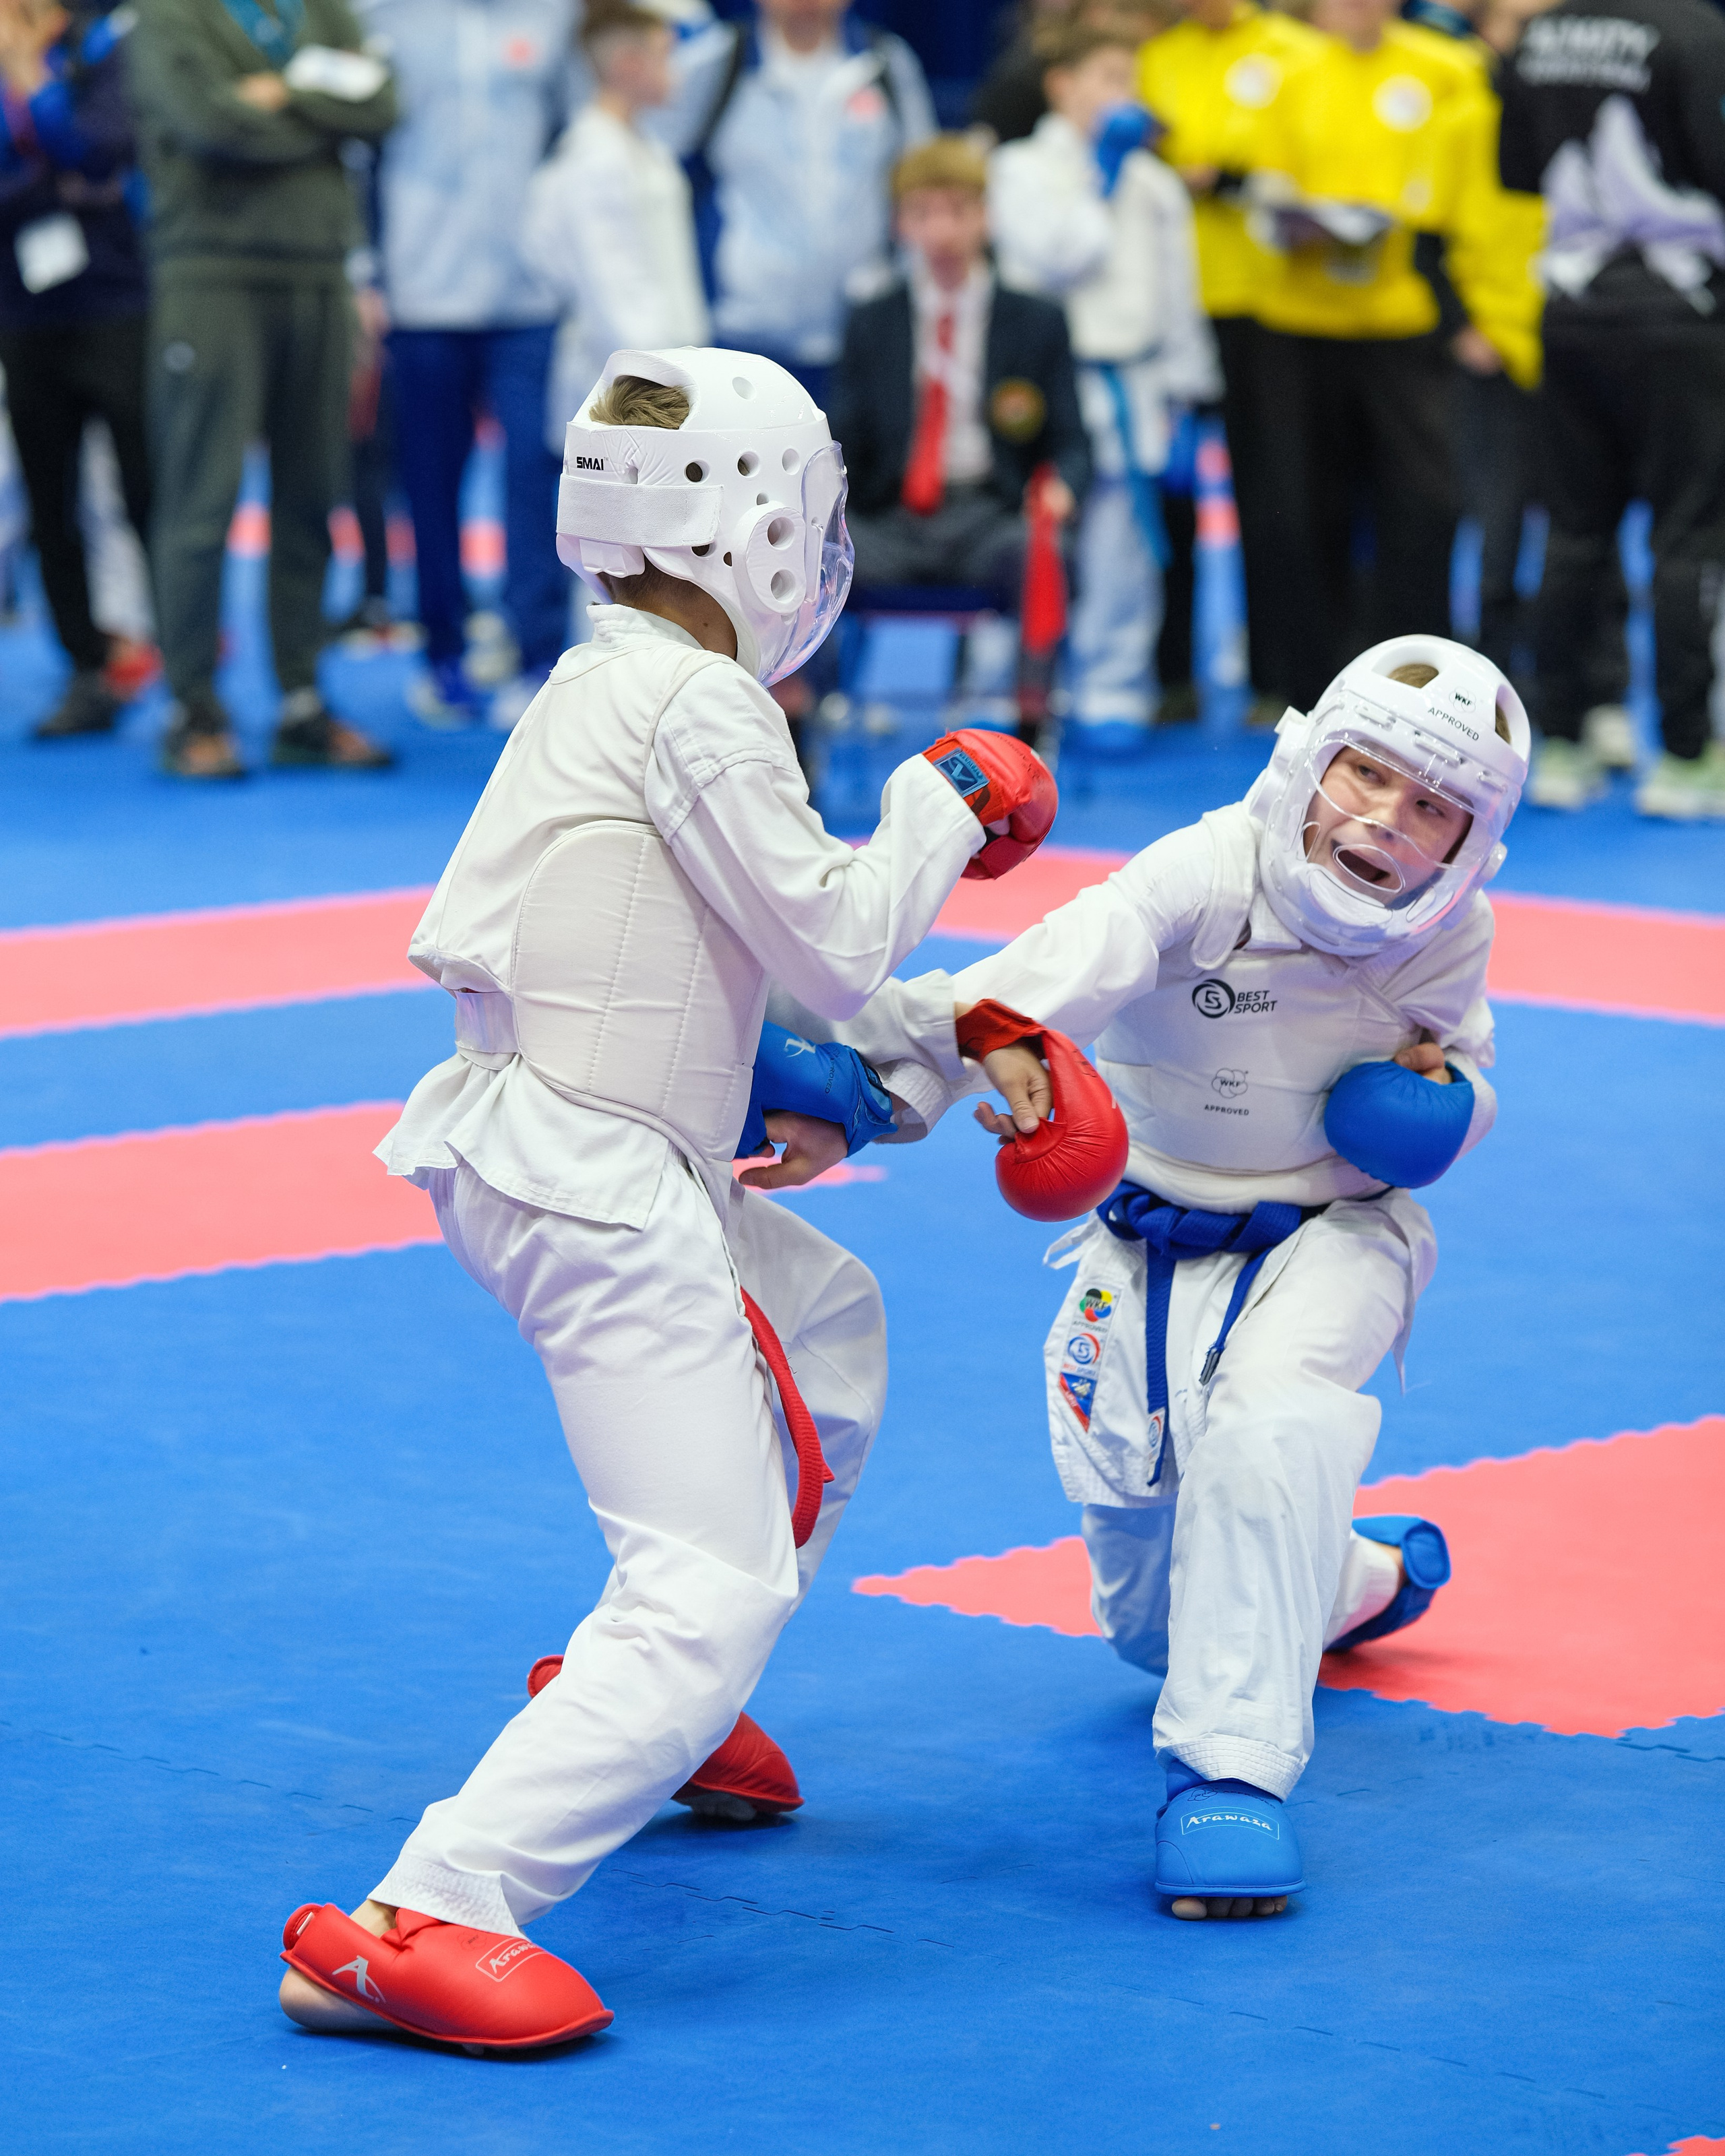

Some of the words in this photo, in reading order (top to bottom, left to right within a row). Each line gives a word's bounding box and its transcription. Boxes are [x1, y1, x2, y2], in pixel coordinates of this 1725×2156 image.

[1427, 707, 1479, 741] APPROVED
[1237, 990, 1270, 1003] BEST
[1233, 1000, 1278, 1014] SPORT
[1204, 1104, 1249, 1116] APPROVED
[1186, 1814, 1273, 1831] Arawaza
